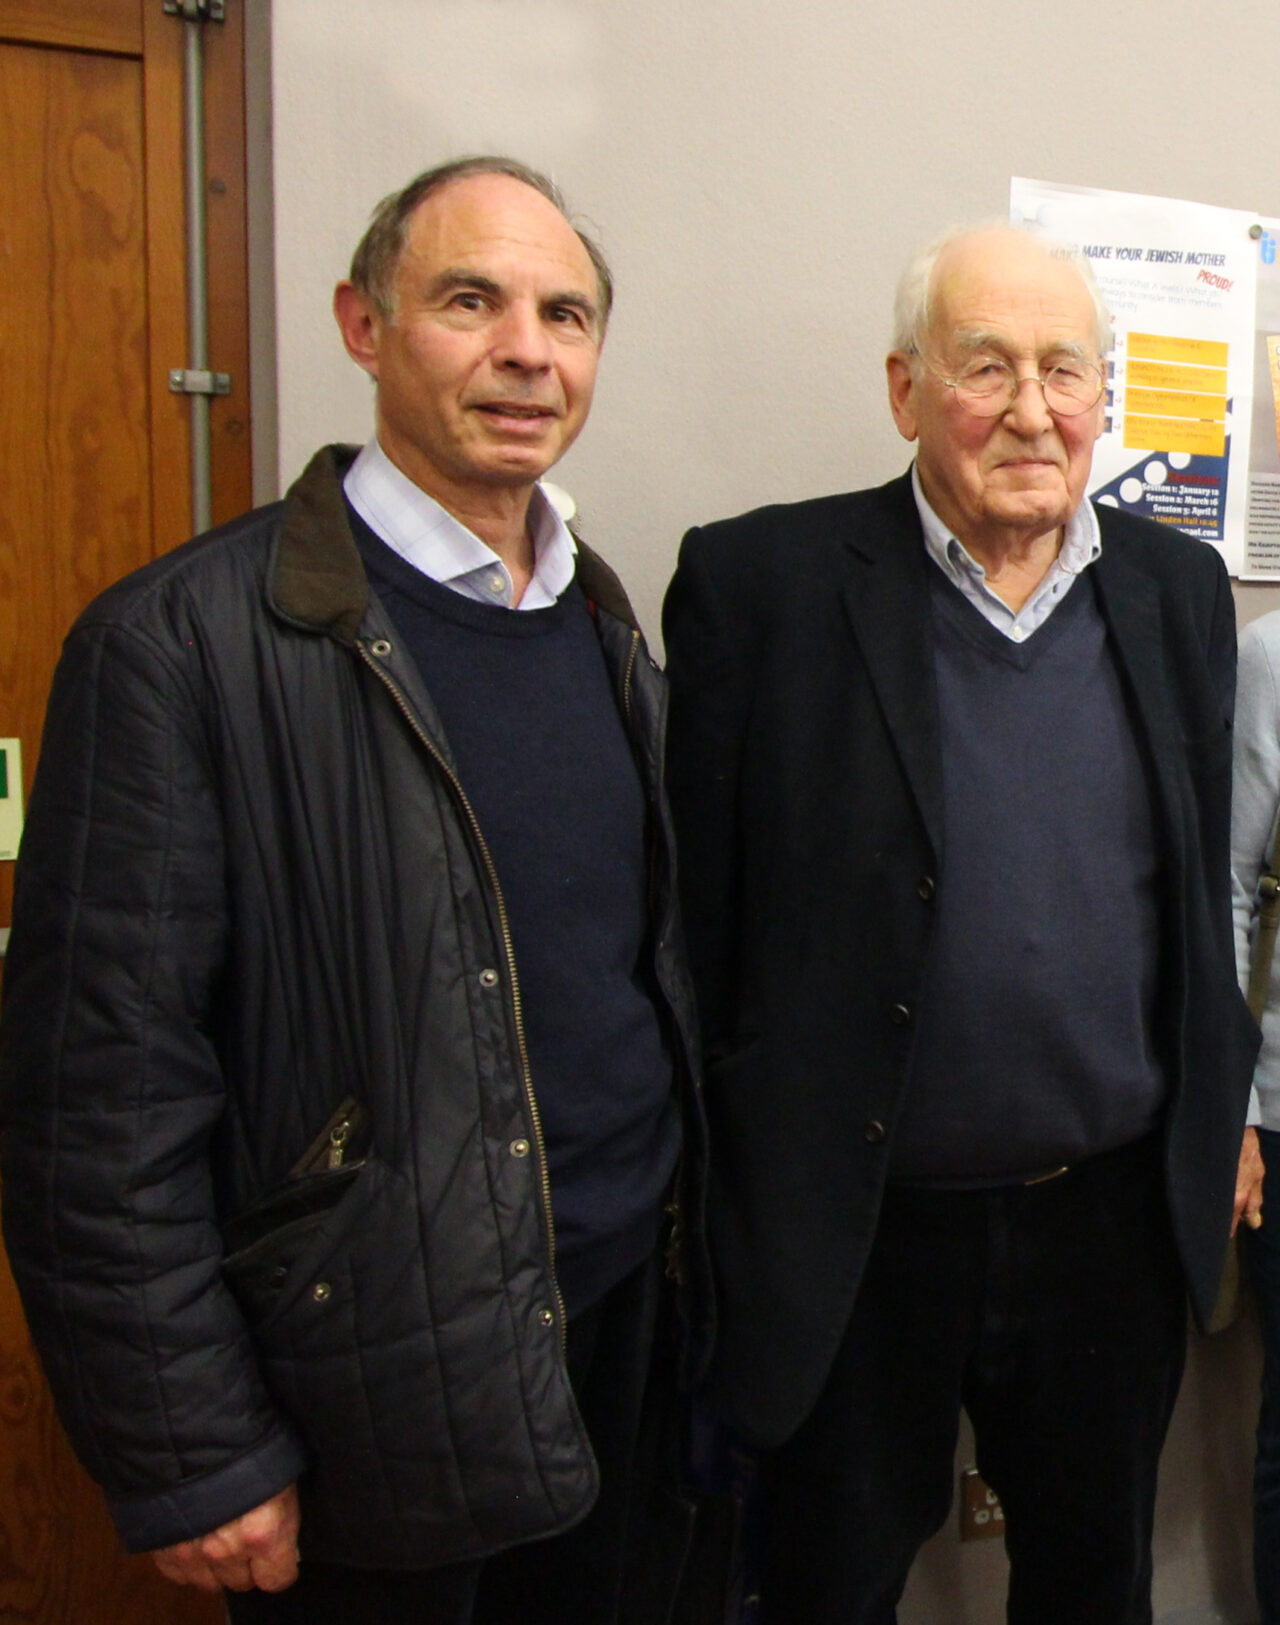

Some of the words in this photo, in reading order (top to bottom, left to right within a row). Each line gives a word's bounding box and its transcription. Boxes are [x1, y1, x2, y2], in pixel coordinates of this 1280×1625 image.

[1082, 245, 1113, 260] MAKE
[1115, 247, 1143, 262] YOUR
[1144, 249, 1183, 265] JEWISH
[1184, 251, 1226, 267] MOTHER
[1197, 269, 1235, 292] PROUD!
[1179, 485, 1211, 497] January
[1145, 493, 1175, 503] Session
[1184, 495, 1209, 506] March
[1152, 503, 1182, 514] Session
[1191, 506, 1211, 517] April
